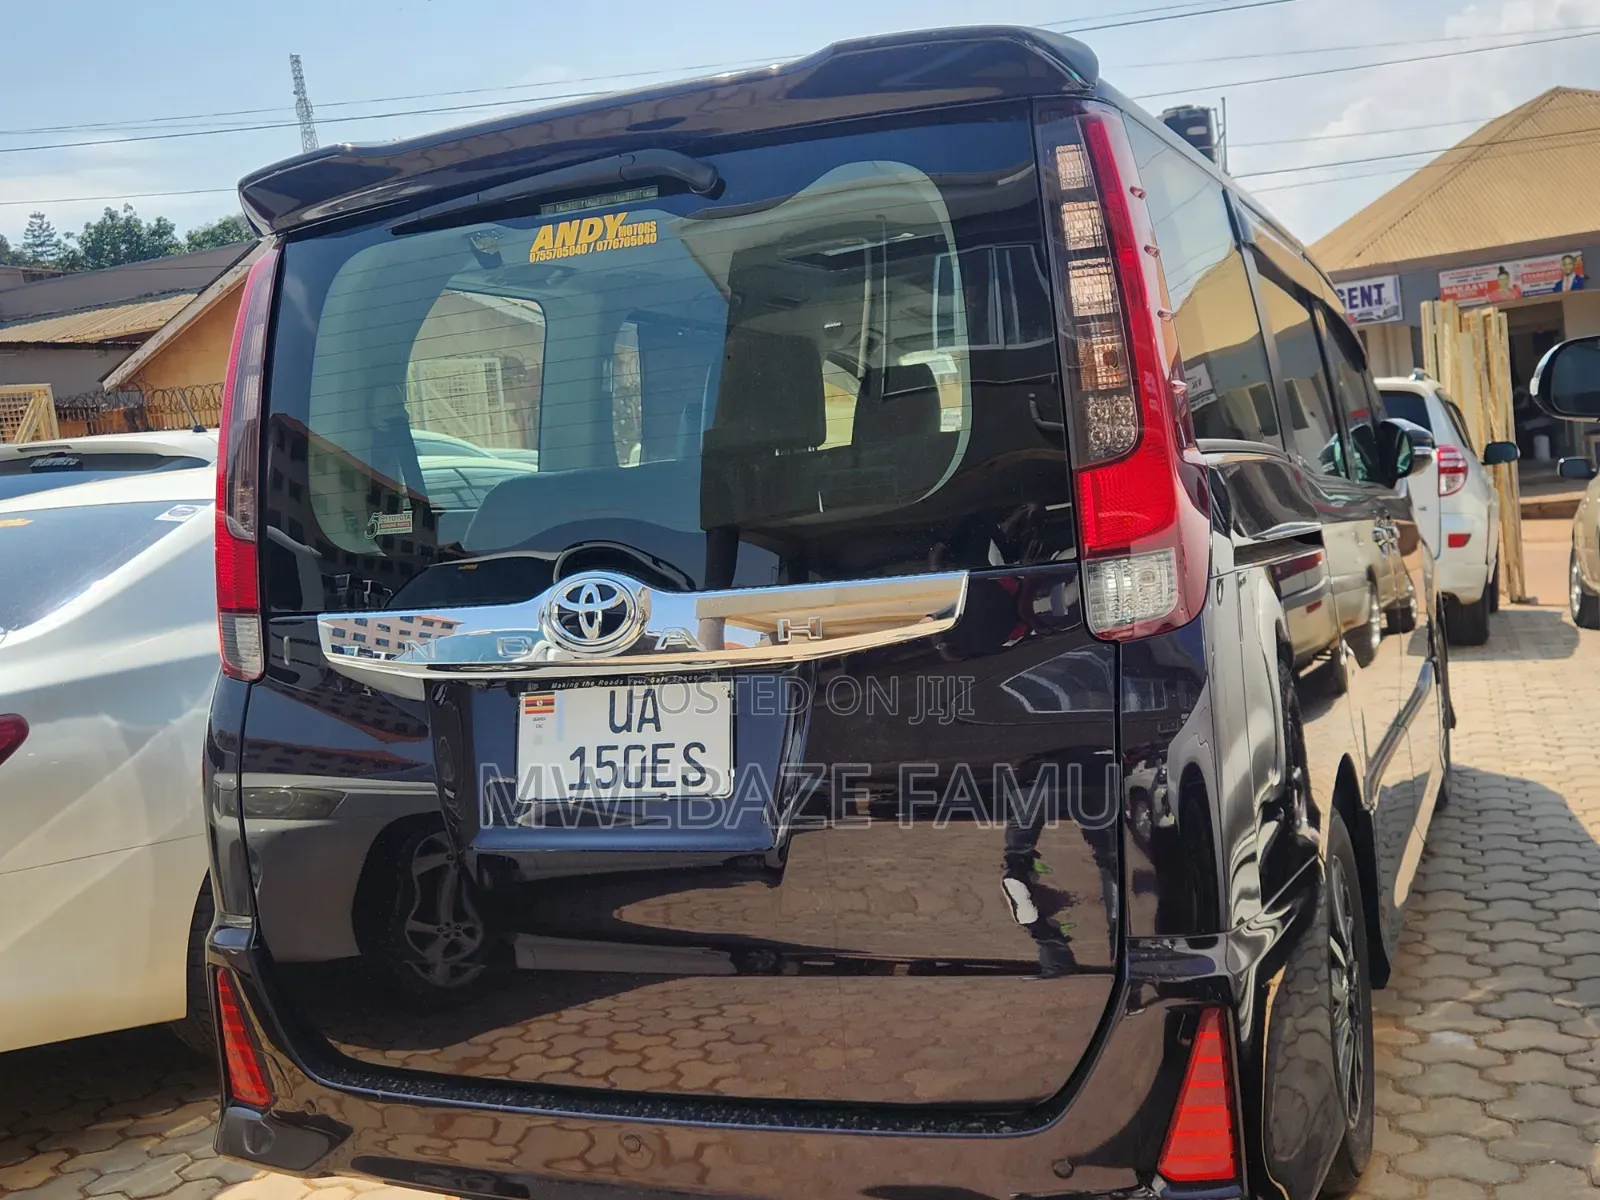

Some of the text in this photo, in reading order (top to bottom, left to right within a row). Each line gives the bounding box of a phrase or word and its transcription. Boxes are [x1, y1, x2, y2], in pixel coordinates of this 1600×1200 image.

[529, 243, 587, 264] 0755705040
[596, 233, 657, 252] 0776705040
[530, 212, 657, 253] ANDY MOTORS
[388, 514, 411, 522] TOYOTA
[551, 681, 580, 690] Making
[581, 679, 595, 688] the
[598, 678, 624, 687] Roads
[609, 687, 662, 734] UA
[568, 741, 707, 791] 150ES
